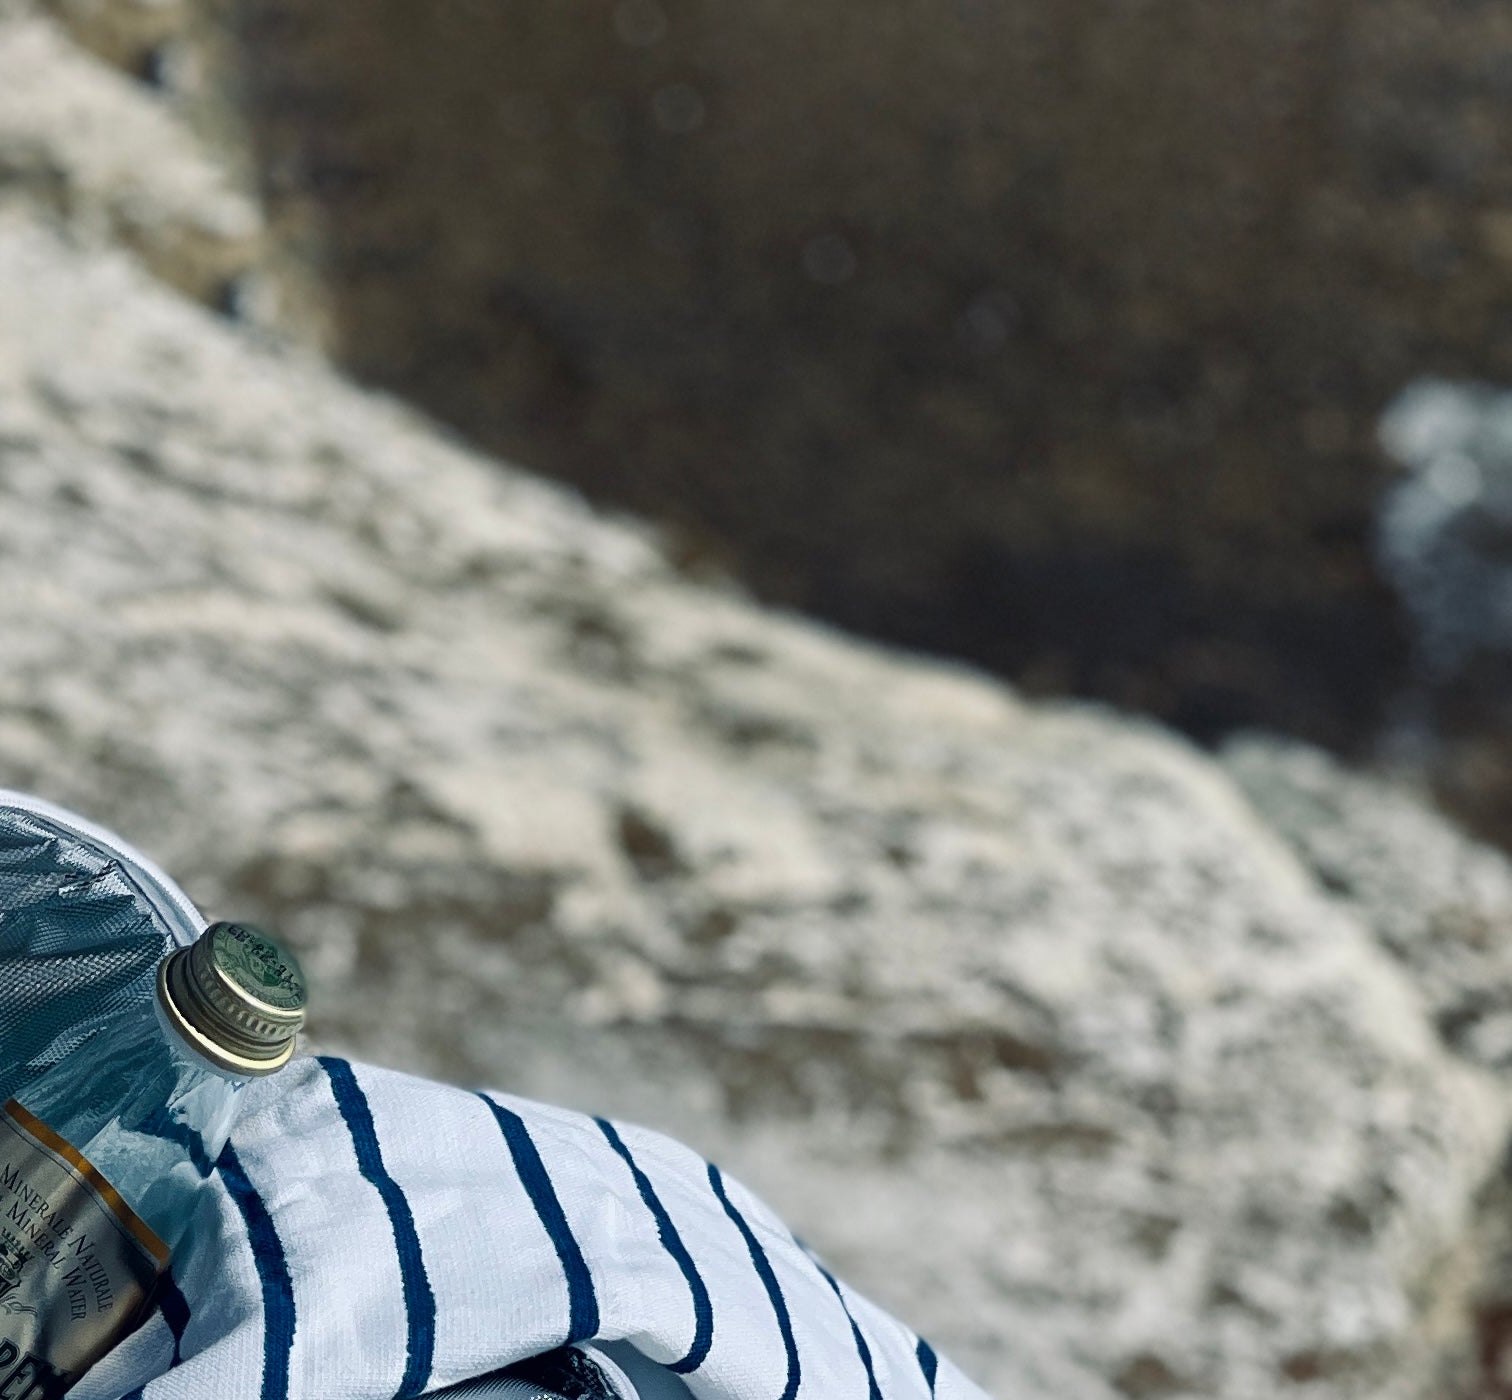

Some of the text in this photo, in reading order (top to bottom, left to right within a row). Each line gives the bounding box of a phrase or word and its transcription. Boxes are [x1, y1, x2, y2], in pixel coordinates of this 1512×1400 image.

[5, 1200, 66, 1270] MINERAL
[61, 1267, 88, 1322] WATER
[67, 1234, 114, 1314] NATURALE
